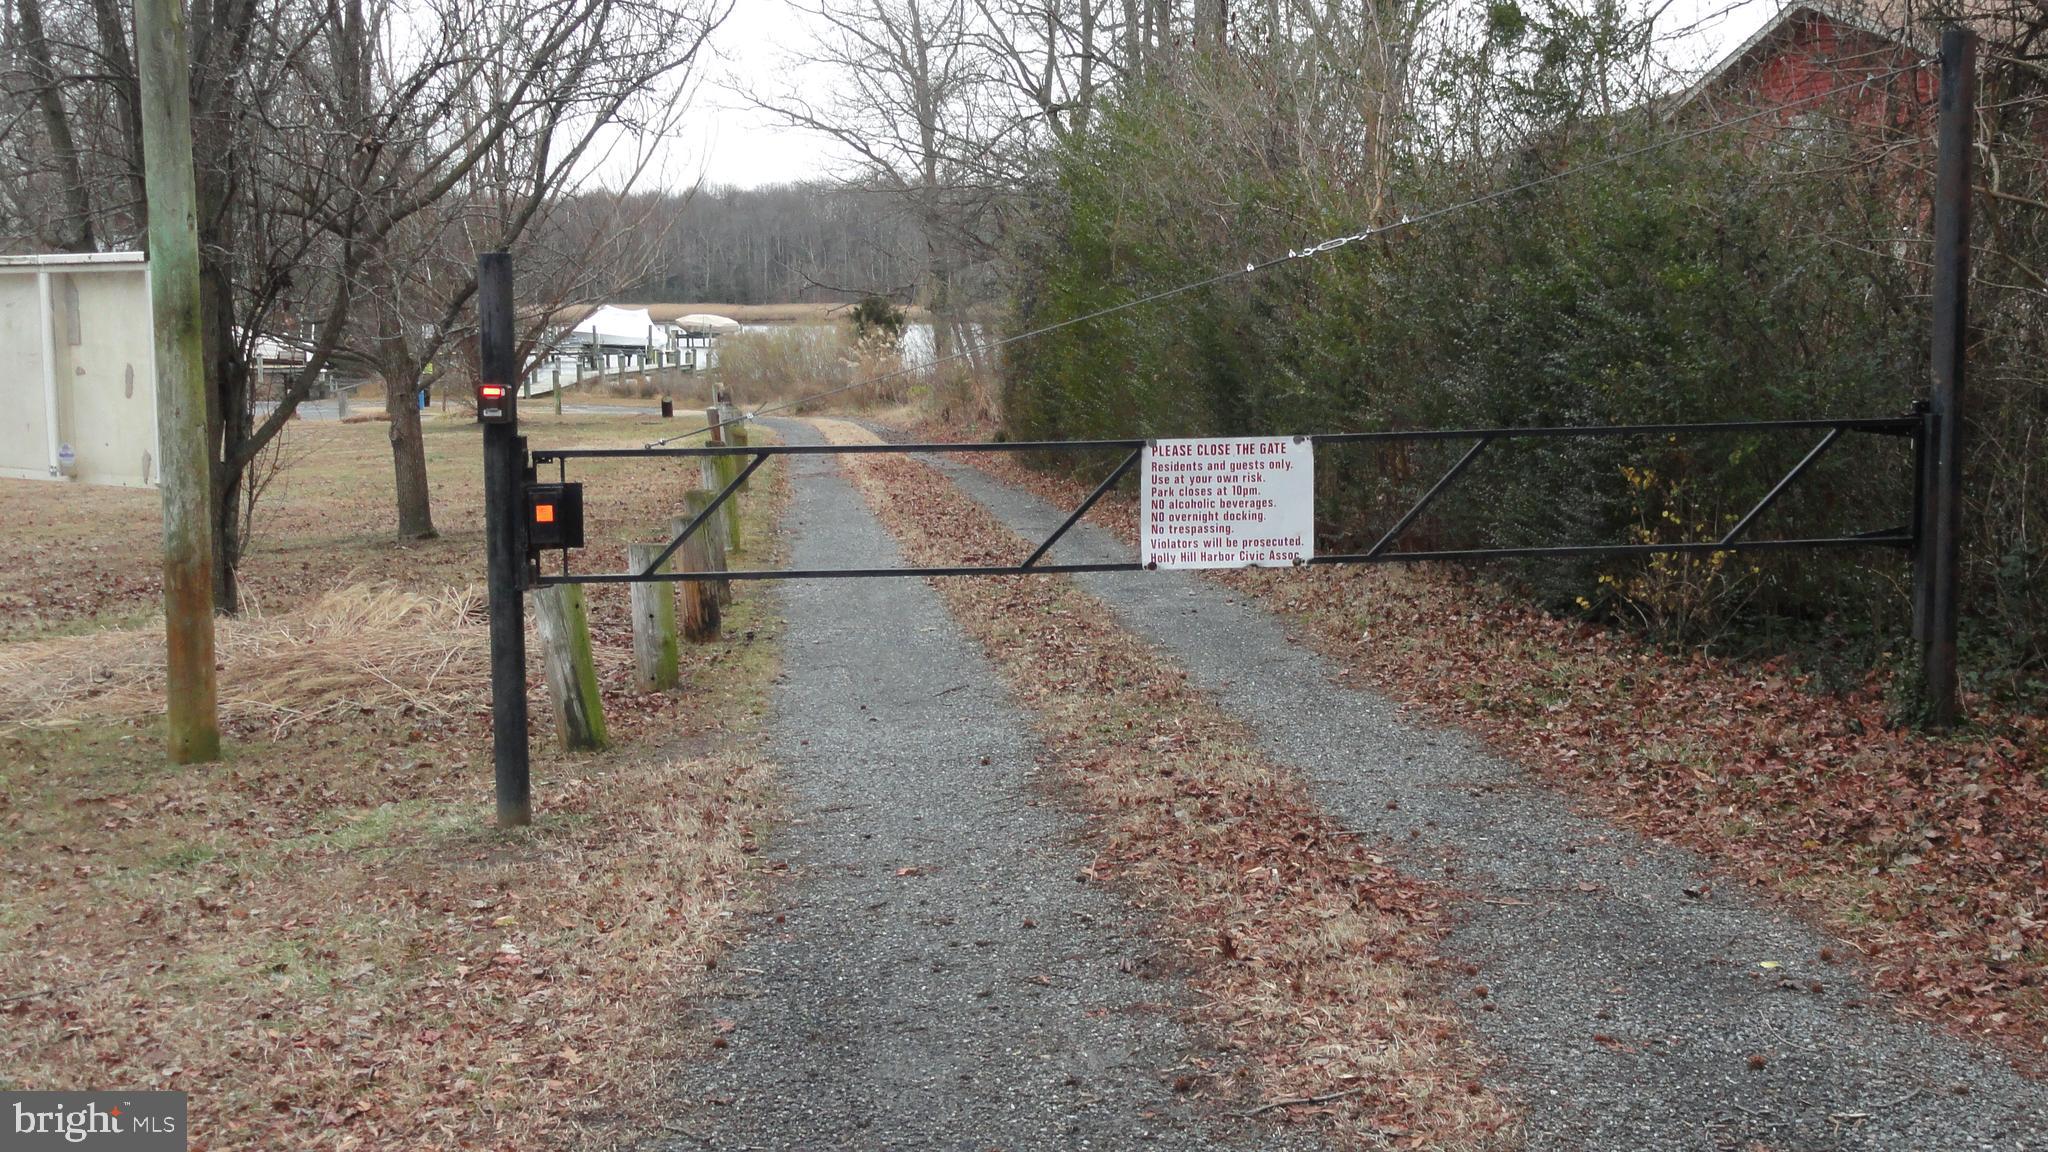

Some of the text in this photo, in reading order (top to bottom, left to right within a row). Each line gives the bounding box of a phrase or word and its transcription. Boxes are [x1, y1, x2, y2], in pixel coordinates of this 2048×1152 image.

[1152, 442, 1286, 457] PLEASE CLOSE THE GATE
[1151, 459, 1293, 472] Residents and guests only.
[1151, 472, 1265, 486] Use at your own risk.
[1151, 485, 1261, 497] Park closes at 10pm.
[1151, 499, 1276, 510] NO alcoholic beverages.
[1151, 511, 1266, 523] NO overnight docking.
[1151, 523, 1234, 535] No trespassing.
[1151, 536, 1304, 549] Violators will be prosecuted.
[1151, 553, 1176, 564] Holly
[1181, 552, 1196, 562] Hill
[1201, 552, 1235, 561] Harbor
[1240, 551, 1264, 561] Civic
